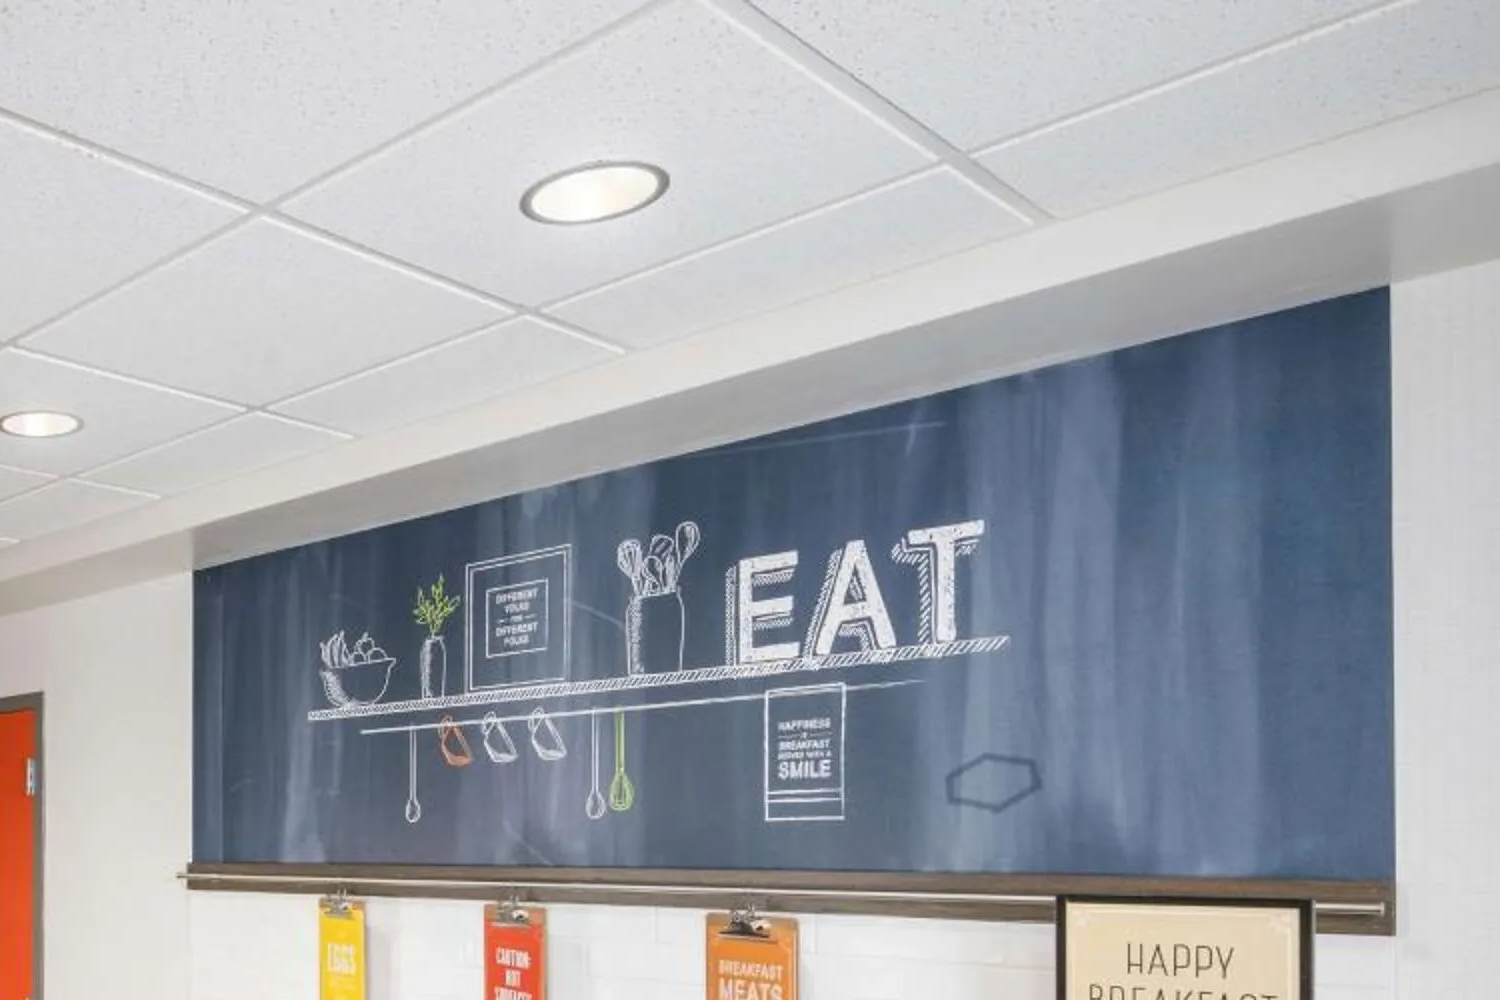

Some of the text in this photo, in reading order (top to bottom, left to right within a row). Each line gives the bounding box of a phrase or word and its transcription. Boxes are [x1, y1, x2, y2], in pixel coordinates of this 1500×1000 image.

[727, 519, 985, 666] EAT
[779, 740, 831, 751] BREAKFAST
[778, 760, 832, 780] SMILE
[718, 959, 784, 981] BREAKFAST
[1126, 942, 1235, 979] HAPPY
